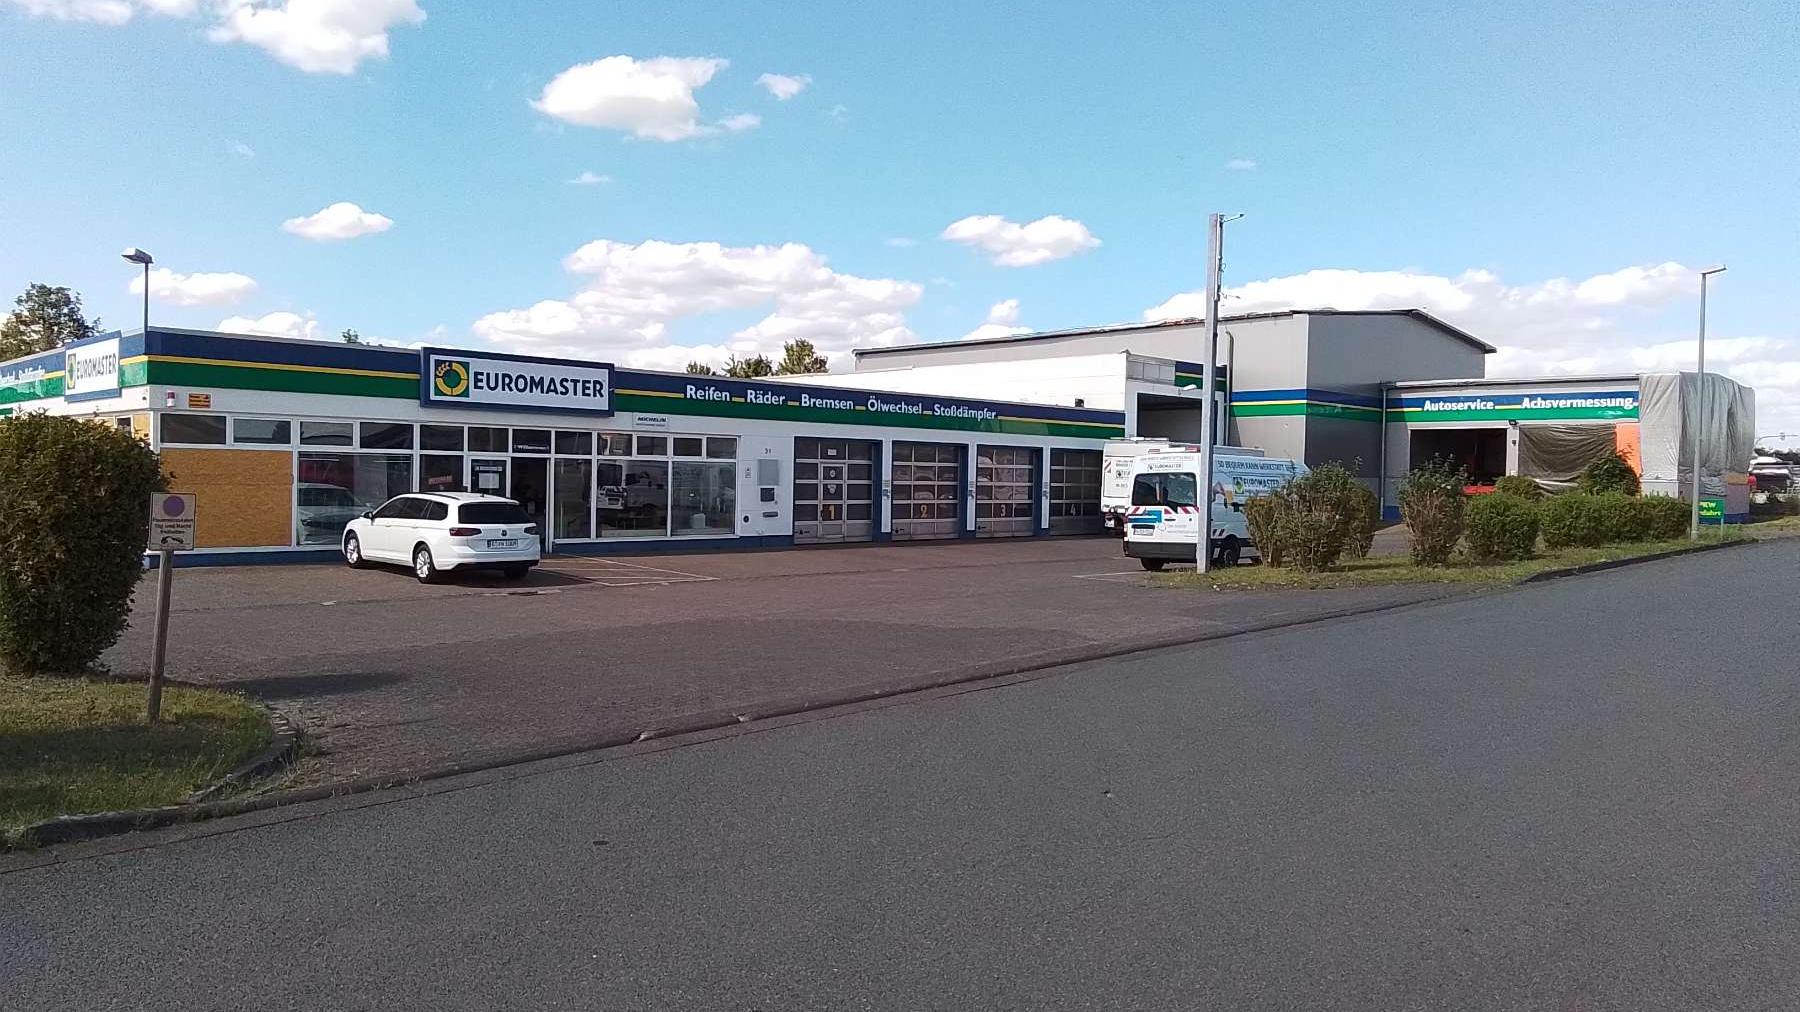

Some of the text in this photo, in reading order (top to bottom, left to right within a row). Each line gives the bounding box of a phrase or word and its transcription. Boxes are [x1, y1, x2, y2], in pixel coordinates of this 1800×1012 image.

[76, 353, 117, 380] EUROMASTER
[473, 371, 605, 398] EUROMASTER
[686, 384, 997, 422] Reifen Räder Bremsen Ölwechsel Stoßdämpfer
[1423, 397, 1634, 412] Autoservice Achsvermessung
[828, 504, 836, 520] 1
[920, 504, 928, 518] 2
[1000, 504, 1006, 516] 3
[1069, 504, 1076, 516] 4
